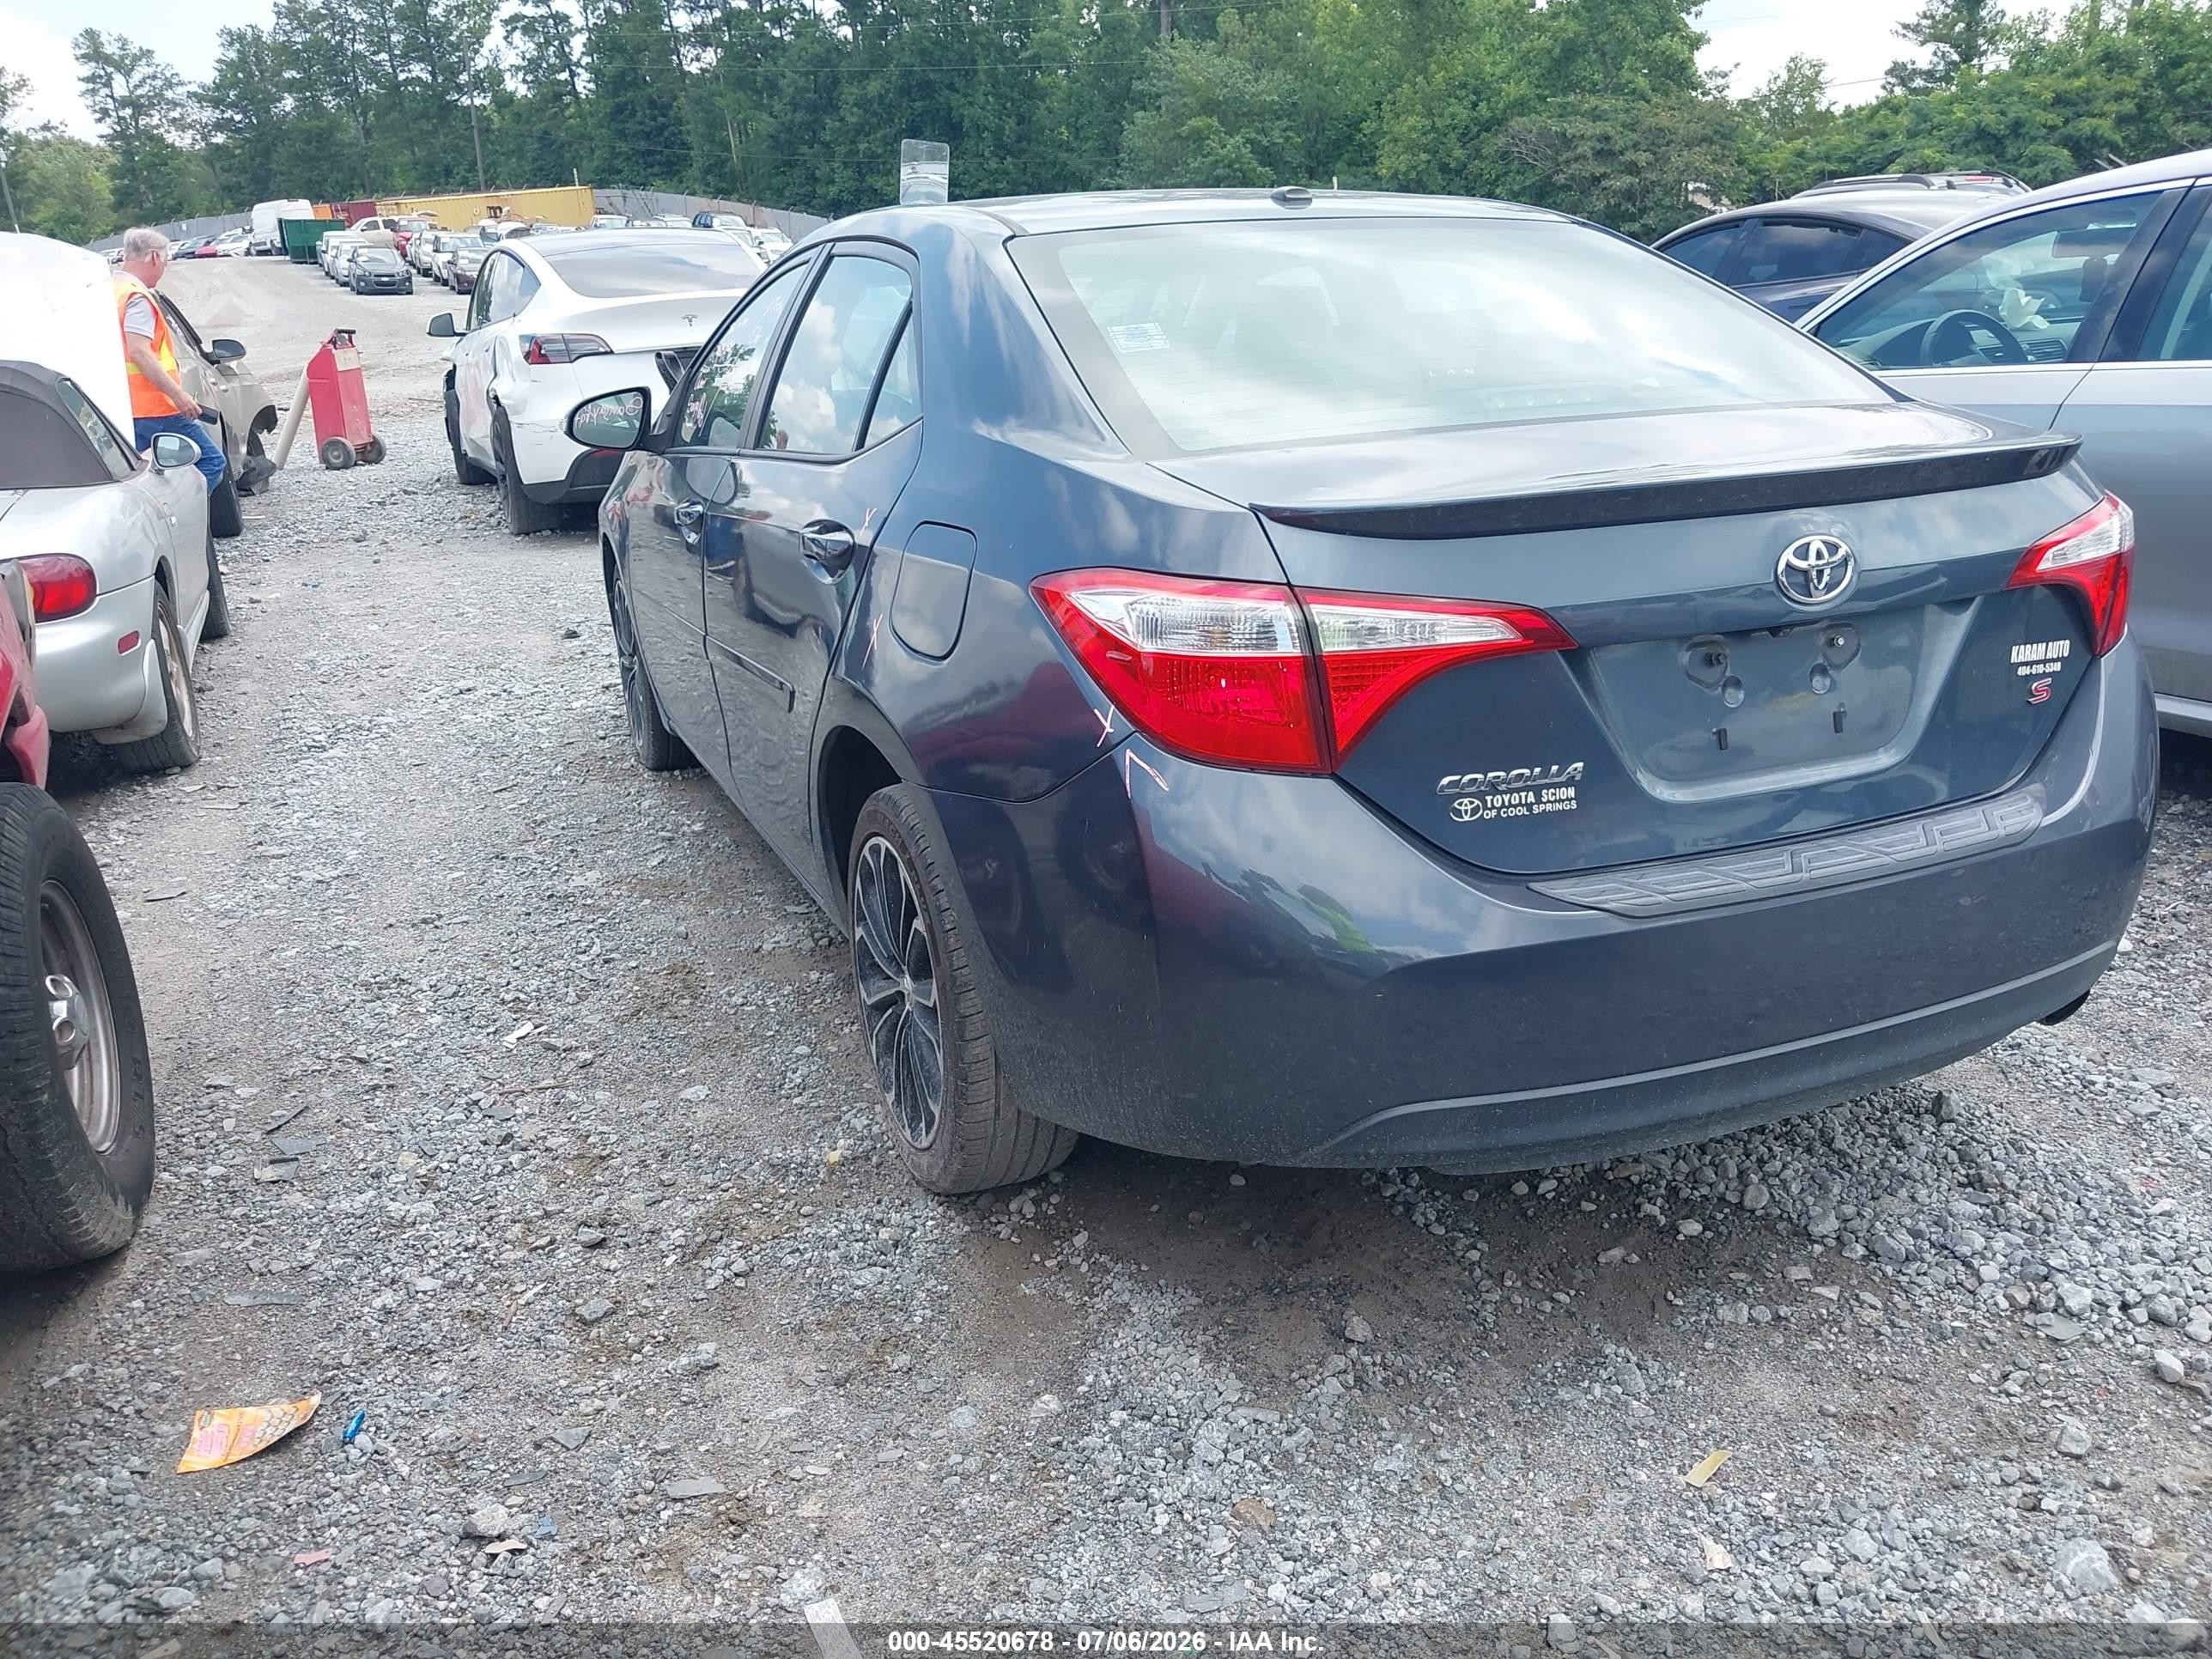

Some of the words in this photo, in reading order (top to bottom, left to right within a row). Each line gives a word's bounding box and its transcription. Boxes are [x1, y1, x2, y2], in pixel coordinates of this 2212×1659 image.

[2010, 642, 2046, 663] KARAM
[2045, 640, 2070, 659] AUTO
[2027, 678, 2052, 704] S
[1436, 762, 1584, 794] COROLLA
[1483, 809, 1498, 819] OF
[1500, 806, 1530, 817] COOL
[1532, 799, 1577, 814] SPRINGS
[1485, 791, 1535, 808] TOYOTA
[1540, 787, 1575, 802] SCION
